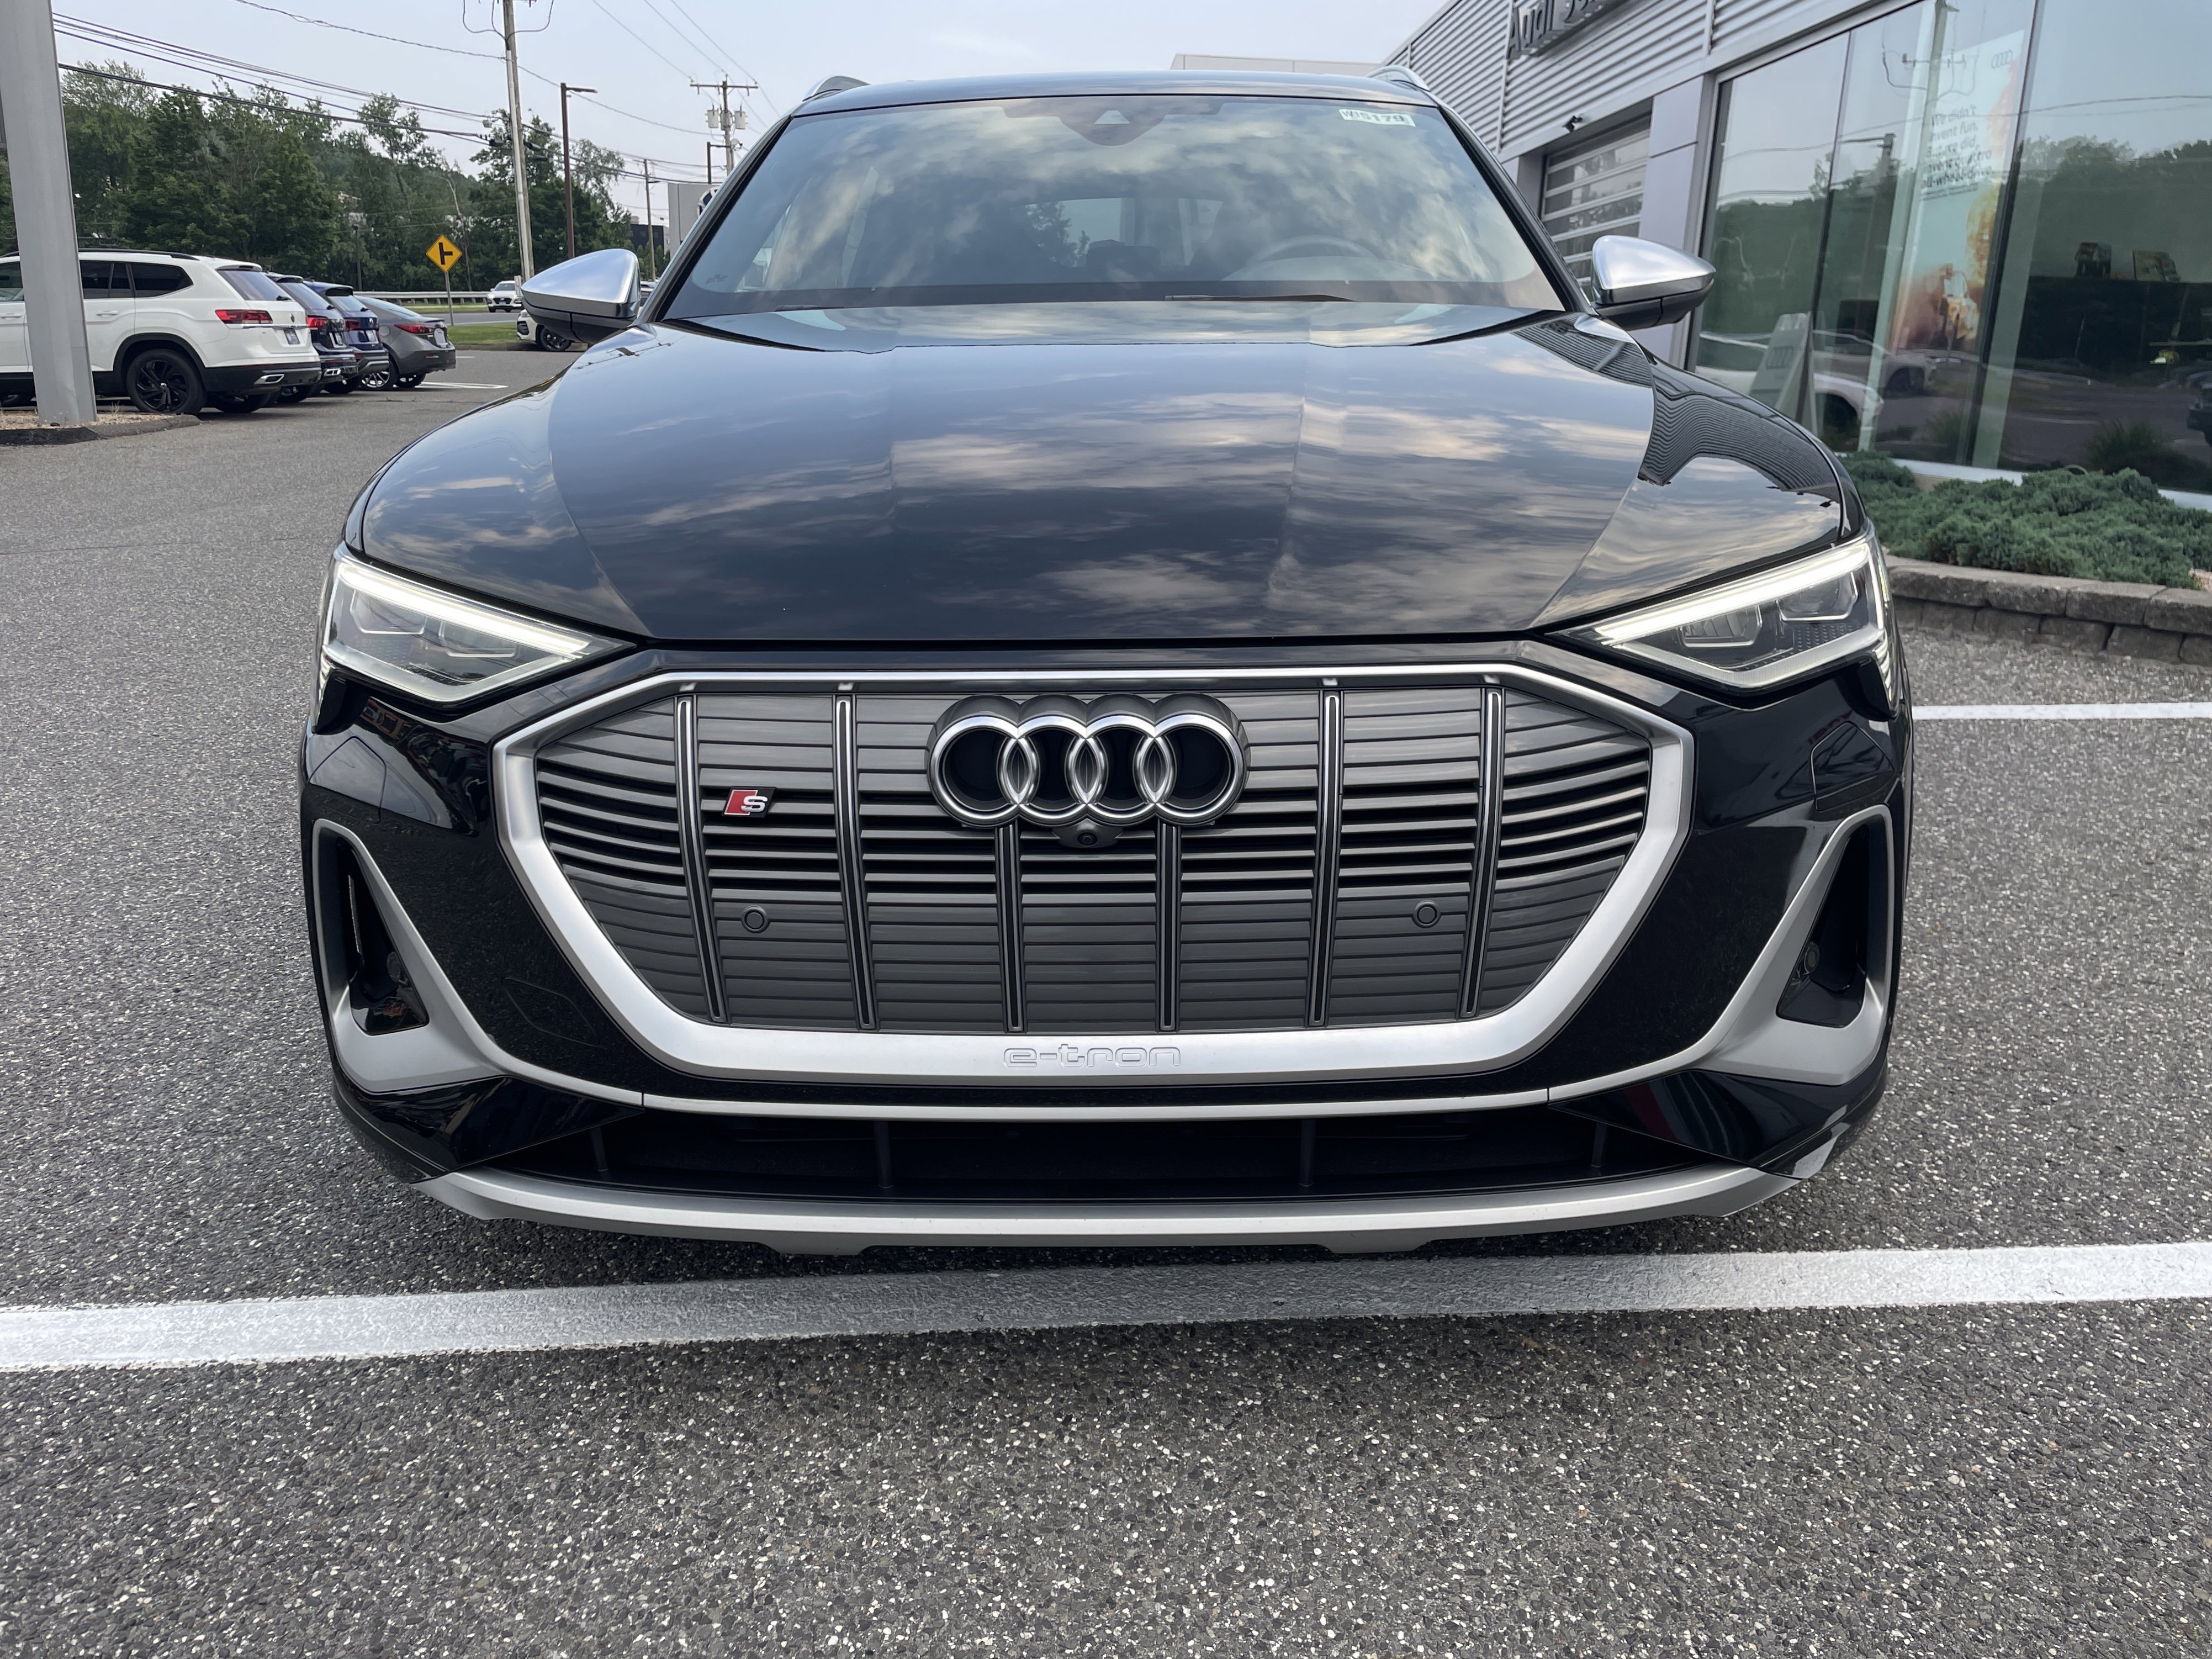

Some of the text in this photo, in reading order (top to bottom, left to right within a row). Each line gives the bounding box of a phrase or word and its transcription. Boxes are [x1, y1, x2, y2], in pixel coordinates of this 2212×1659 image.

[1960, 121, 1979, 135] fun.
[740, 795, 768, 812] S
[1003, 1043, 1181, 1068] e-tron
